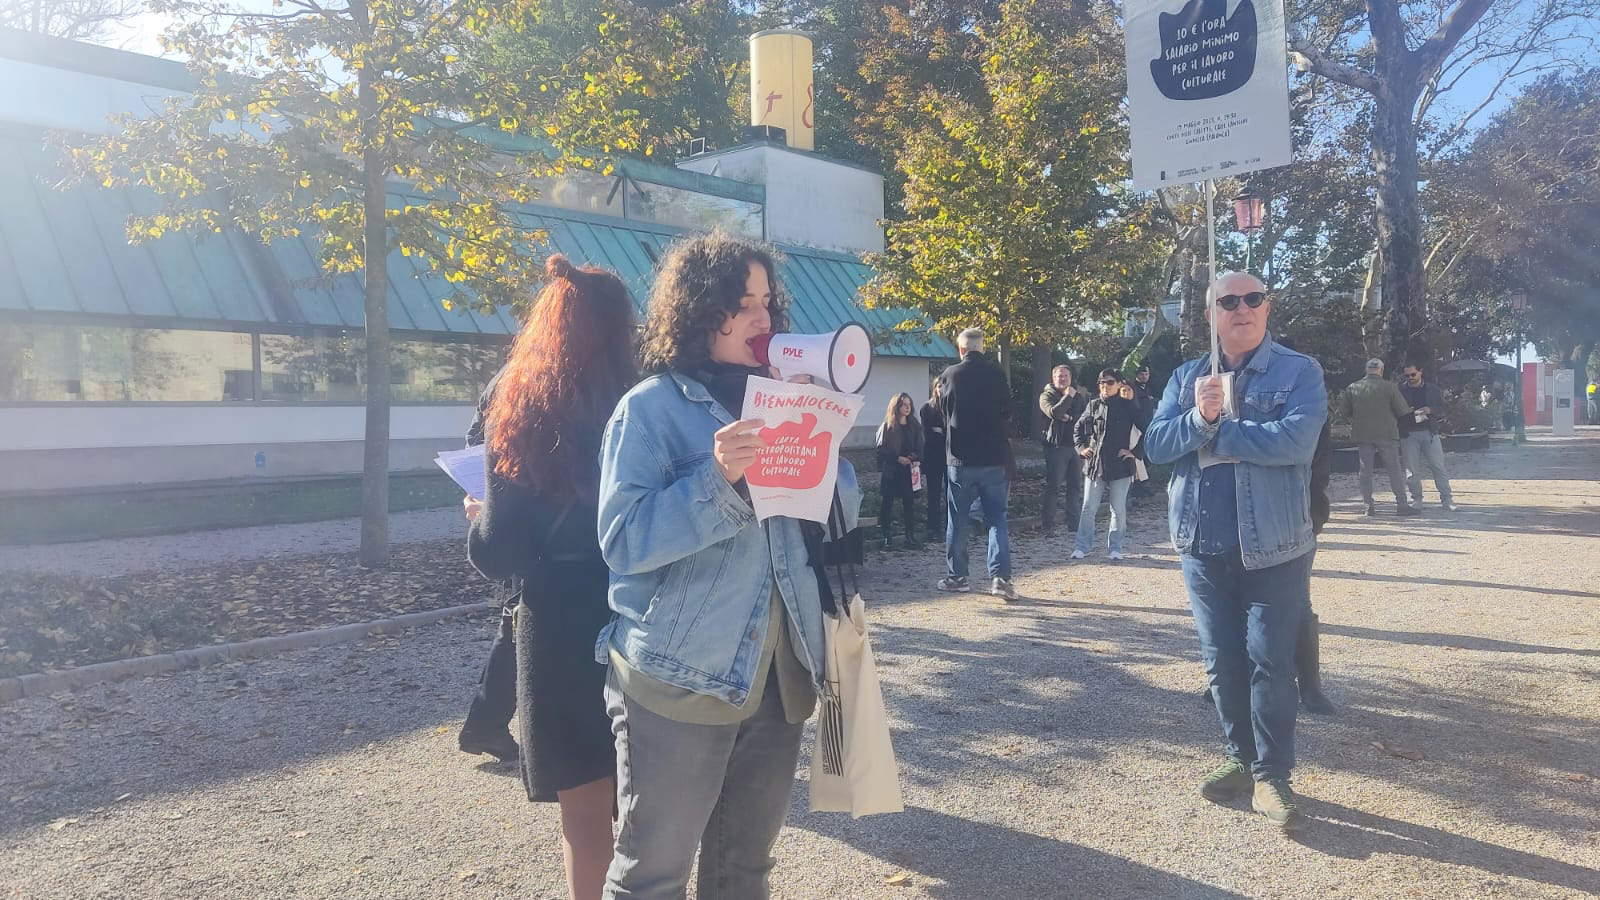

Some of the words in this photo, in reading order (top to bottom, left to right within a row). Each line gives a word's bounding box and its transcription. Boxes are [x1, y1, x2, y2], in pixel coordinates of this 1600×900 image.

[1177, 27, 1187, 40] 10
[1191, 24, 1198, 35] €
[1172, 62, 1187, 76] PER
[783, 347, 803, 358] PYLE
[774, 436, 800, 445] CARTA
